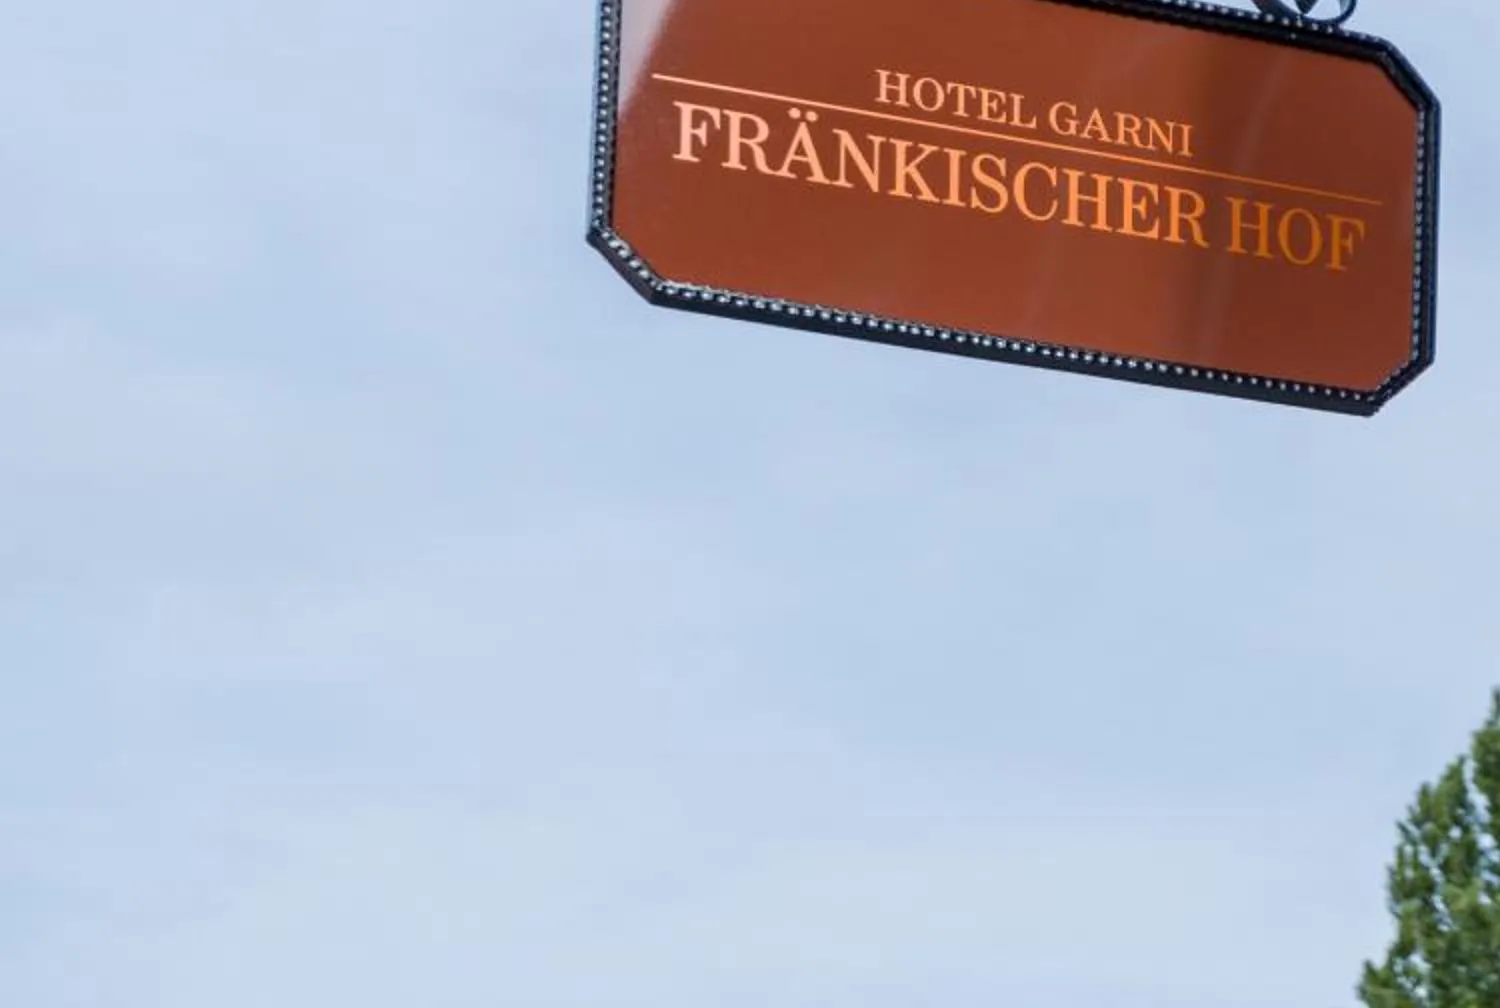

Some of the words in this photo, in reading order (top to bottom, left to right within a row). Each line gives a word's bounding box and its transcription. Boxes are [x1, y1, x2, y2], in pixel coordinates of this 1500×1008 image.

[876, 70, 1037, 130] HOTEL
[1050, 101, 1195, 157] GARNI
[673, 102, 1208, 248] FRÄNKISCHER
[1226, 200, 1366, 272] HOF
